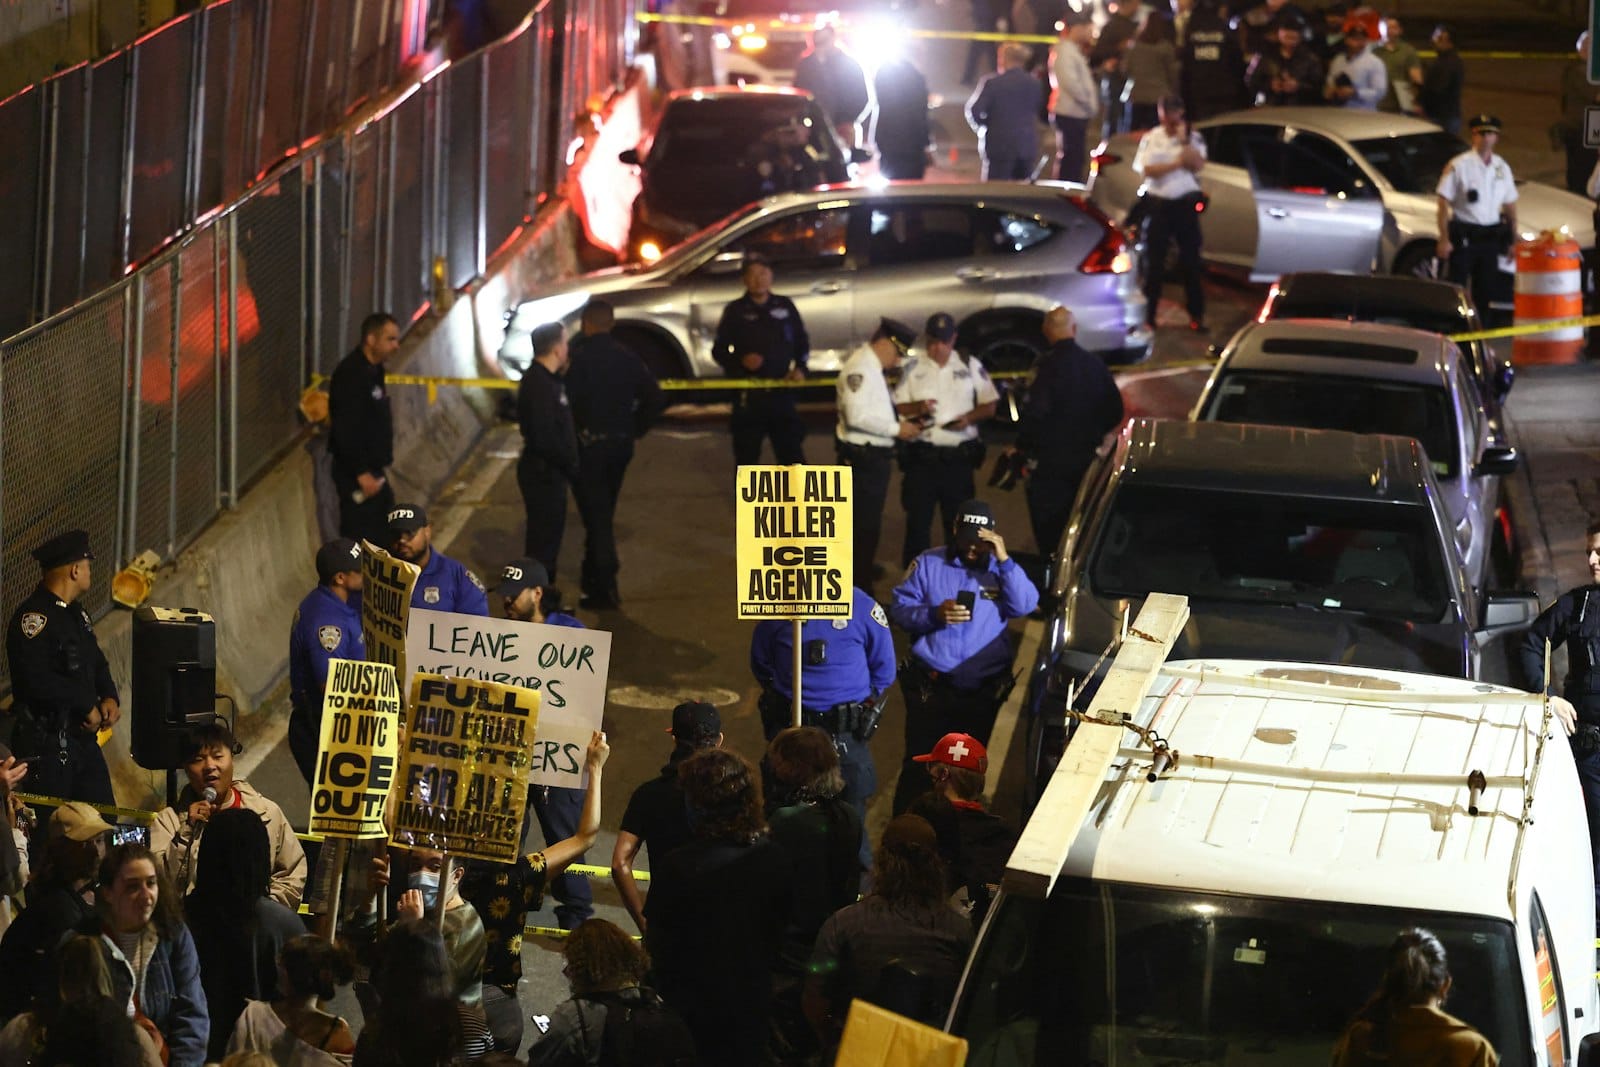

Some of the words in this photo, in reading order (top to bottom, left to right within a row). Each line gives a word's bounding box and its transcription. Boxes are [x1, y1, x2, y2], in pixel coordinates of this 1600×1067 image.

[742, 471, 796, 502] JAIL
[804, 471, 847, 502] ALL
[388, 509, 414, 522] NYPD
[754, 506, 836, 538] KILLER
[963, 514, 988, 525] NYPD
[763, 546, 827, 566] ICE
[504, 566, 523, 580] PD
[749, 568, 842, 601] AGENTS
[373, 583, 403, 622] EQUAL
[742, 604, 761, 614] PARTY
[762, 604, 774, 614] FOR
[775, 604, 808, 614] SOCIALISM
[815, 604, 848, 614] LIBERATION
[429, 623, 519, 662] LEAVE
[538, 642, 595, 674] OUR
[333, 662, 395, 698] HOUSTON
[328, 695, 345, 708] TO
[347, 697, 397, 714] MAINE
[420, 679, 530, 717] FULL
[332, 713, 351, 744] TO
[356, 715, 388, 747] NYC
[413, 705, 456, 737] AND
[460, 711, 528, 749] EQUAL
[409, 737, 527, 769] RIGHTS
[530, 741, 582, 775] ERS
[318, 751, 394, 790] ICE
[314, 789, 387, 817] OUT!
[405, 763, 459, 807] FOR
[464, 772, 516, 817] ALL
[397, 801, 518, 842] IMMIGRANTS
